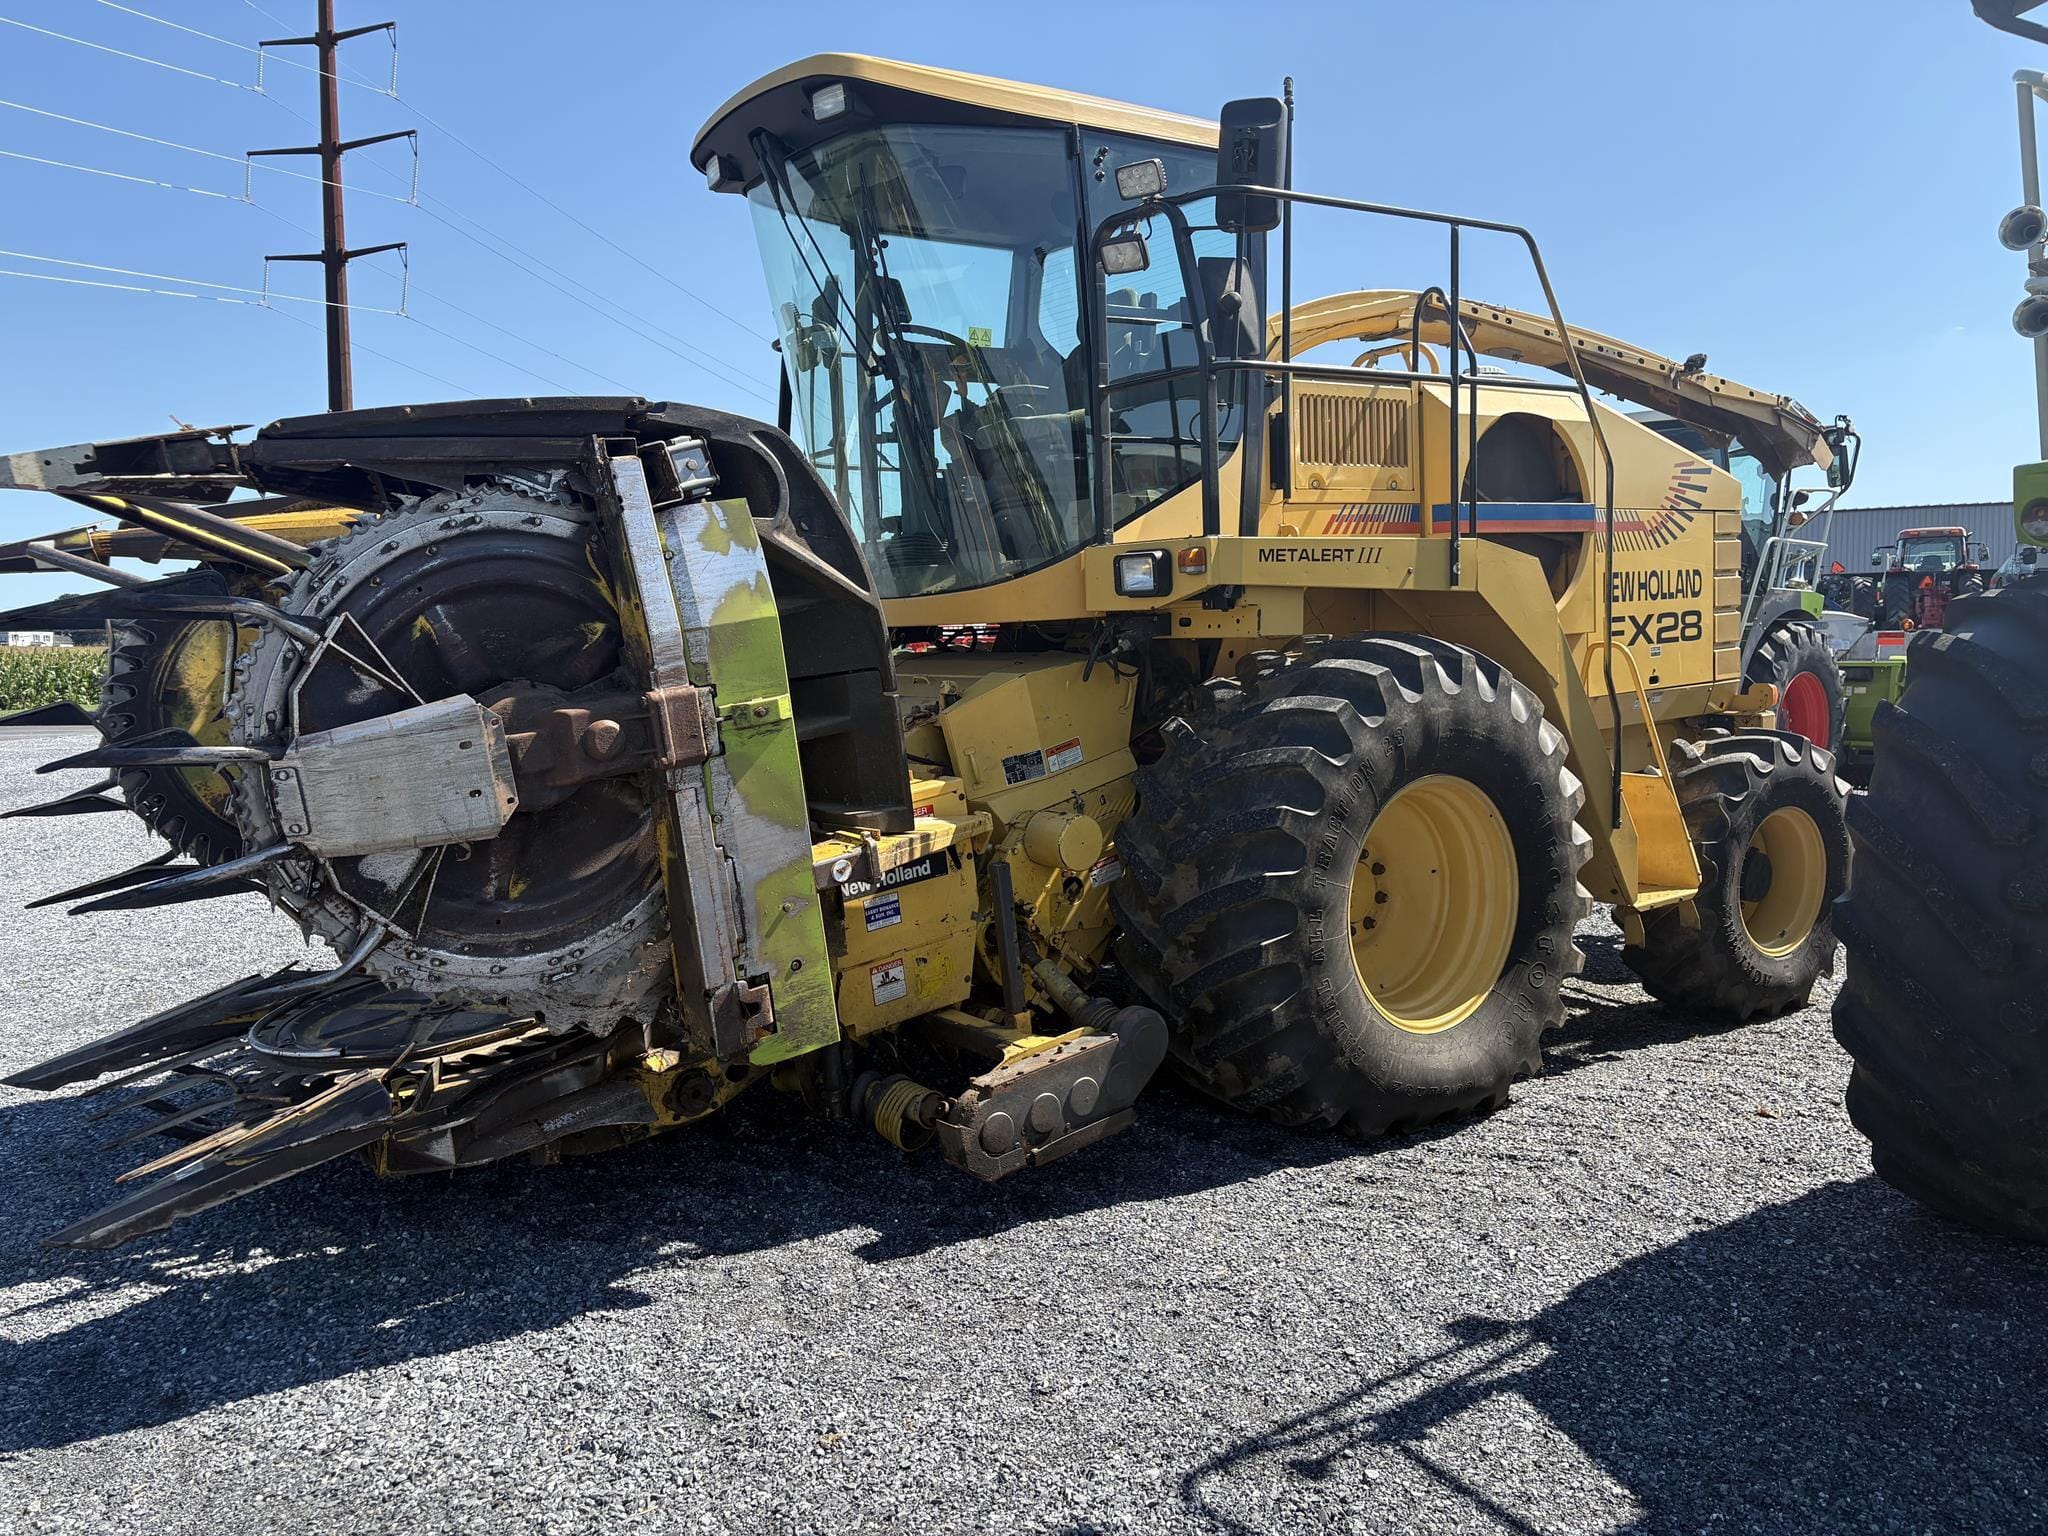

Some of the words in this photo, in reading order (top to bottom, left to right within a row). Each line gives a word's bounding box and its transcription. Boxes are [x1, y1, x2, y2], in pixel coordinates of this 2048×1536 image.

[1258, 548, 1355, 562] METALERT
[1637, 568, 1703, 601] HOLLAND
[1609, 609, 1703, 647] FX28
[840, 880, 871, 897] New
[1307, 908, 1326, 963] ALL
[878, 959, 903, 972] DANGER
